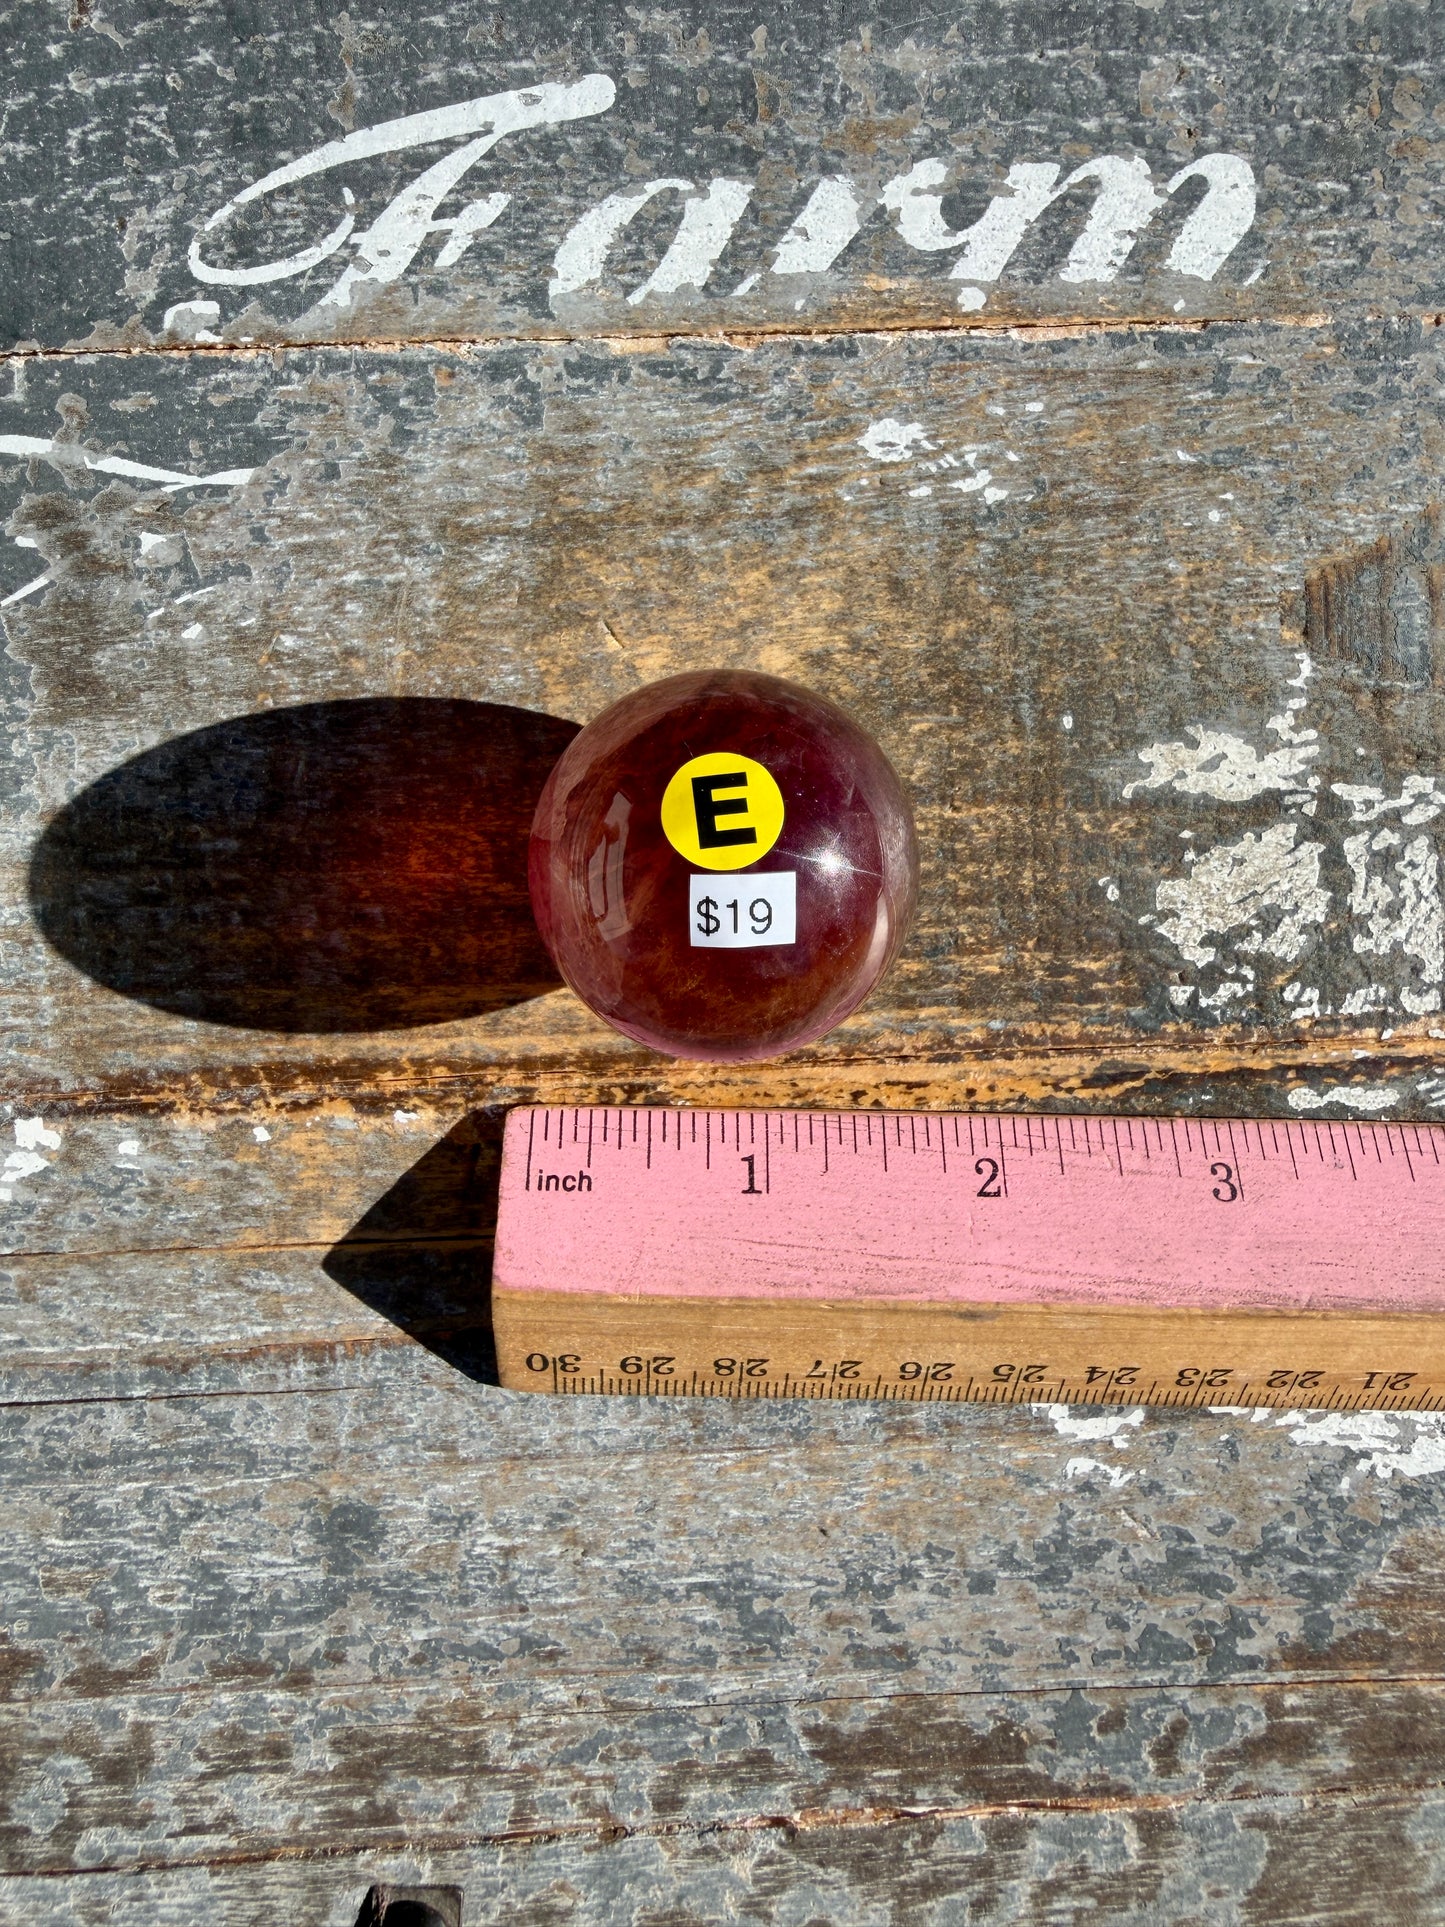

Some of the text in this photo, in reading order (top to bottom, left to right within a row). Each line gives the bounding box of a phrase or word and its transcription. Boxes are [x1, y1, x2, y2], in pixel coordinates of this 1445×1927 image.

[691, 771, 757, 849] E
[697, 895, 773, 937] $19
[537, 1169, 593, 1192] inch
[741, 1154, 763, 1195] 1
[975, 1157, 1001, 1198] 2
[1210, 1162, 1238, 1202] 3
[526, 1352, 1418, 1391] 21 22 23 24 25 26 27 28 29 30
